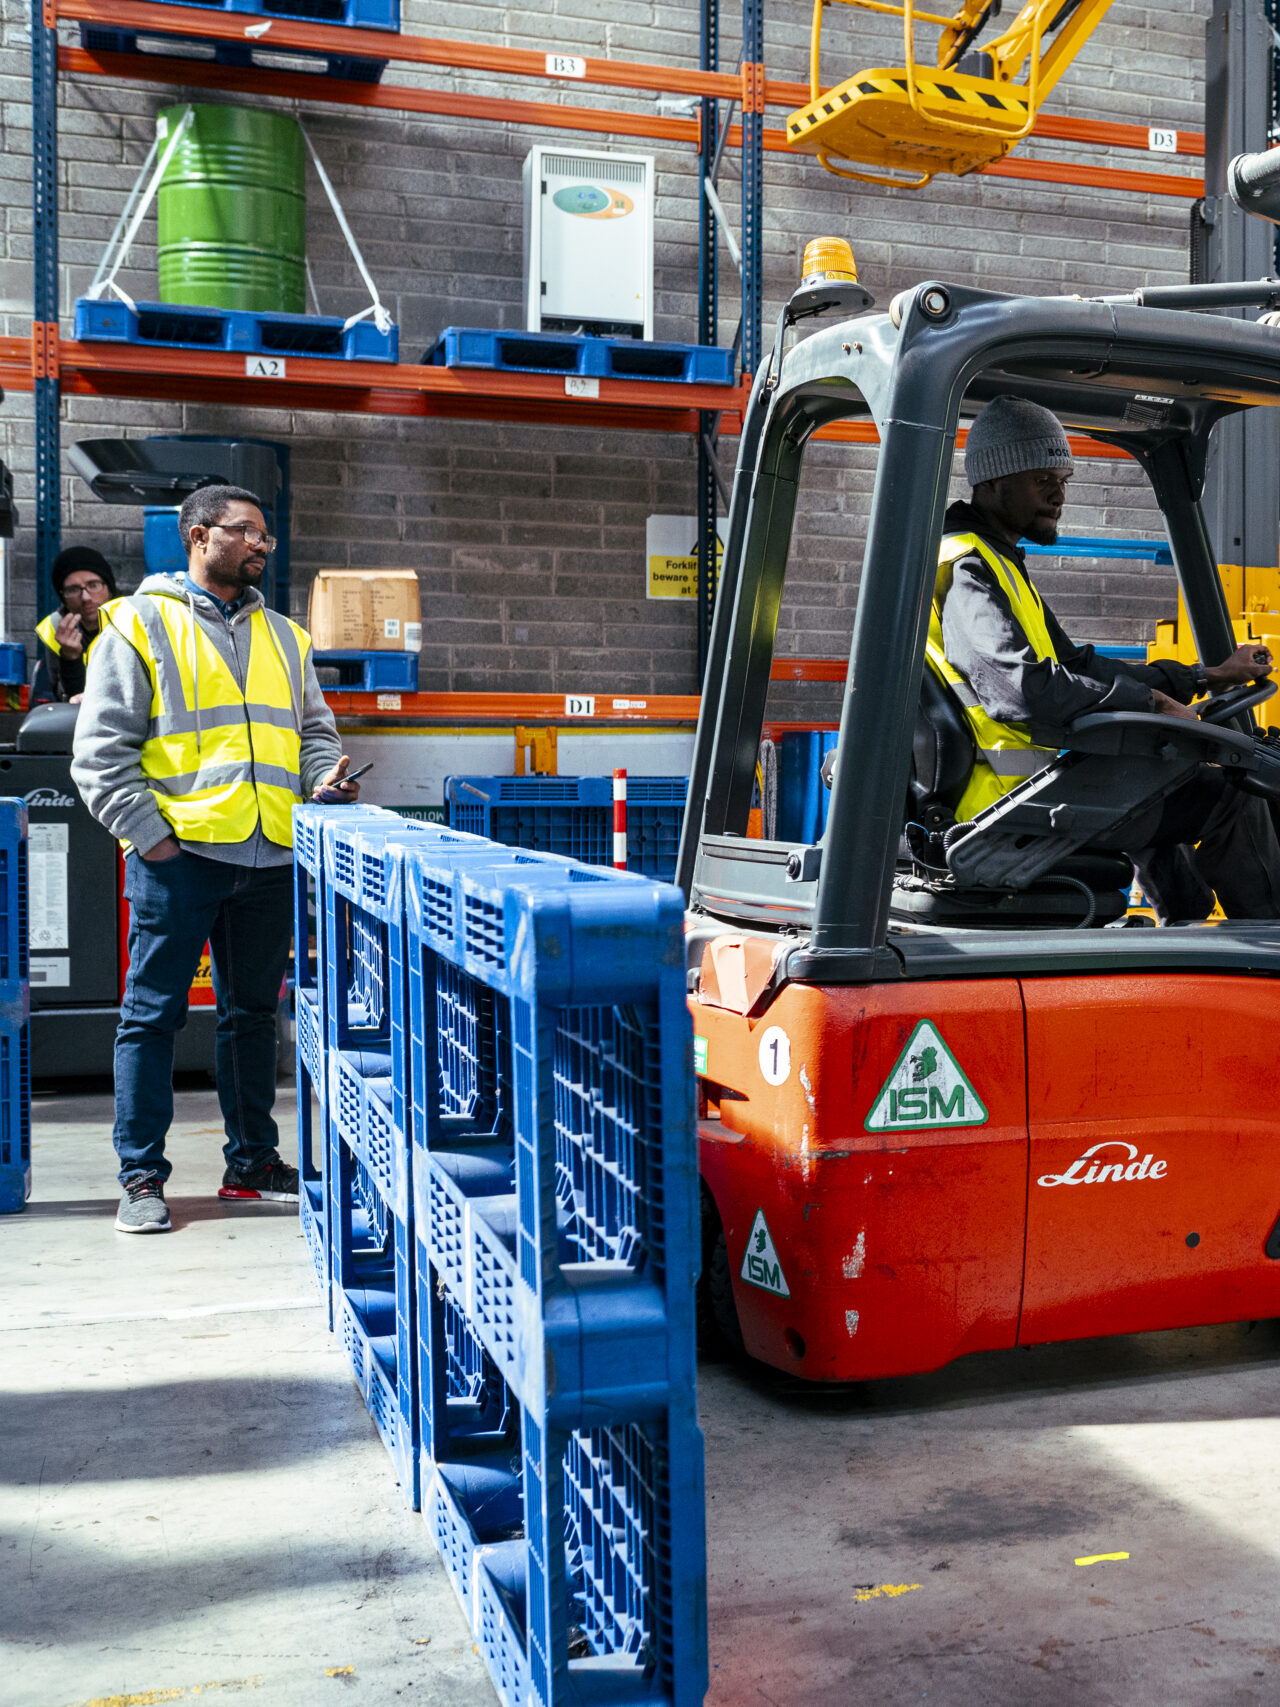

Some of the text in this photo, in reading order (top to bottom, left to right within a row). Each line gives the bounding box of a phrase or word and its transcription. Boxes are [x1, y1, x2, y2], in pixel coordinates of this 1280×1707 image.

[554, 57, 575, 73] B3
[1154, 132, 1173, 147] D3
[253, 360, 279, 376] A2
[666, 560, 698, 571] Forklif
[652, 572, 689, 582] beware
[570, 699, 591, 714] D1
[23, 787, 75, 807] Linde
[769, 1038, 778, 1076] 1
[889, 1084, 965, 1122] ISM
[1037, 1141, 1168, 1187] Linde
[747, 1253, 781, 1290] ISM
